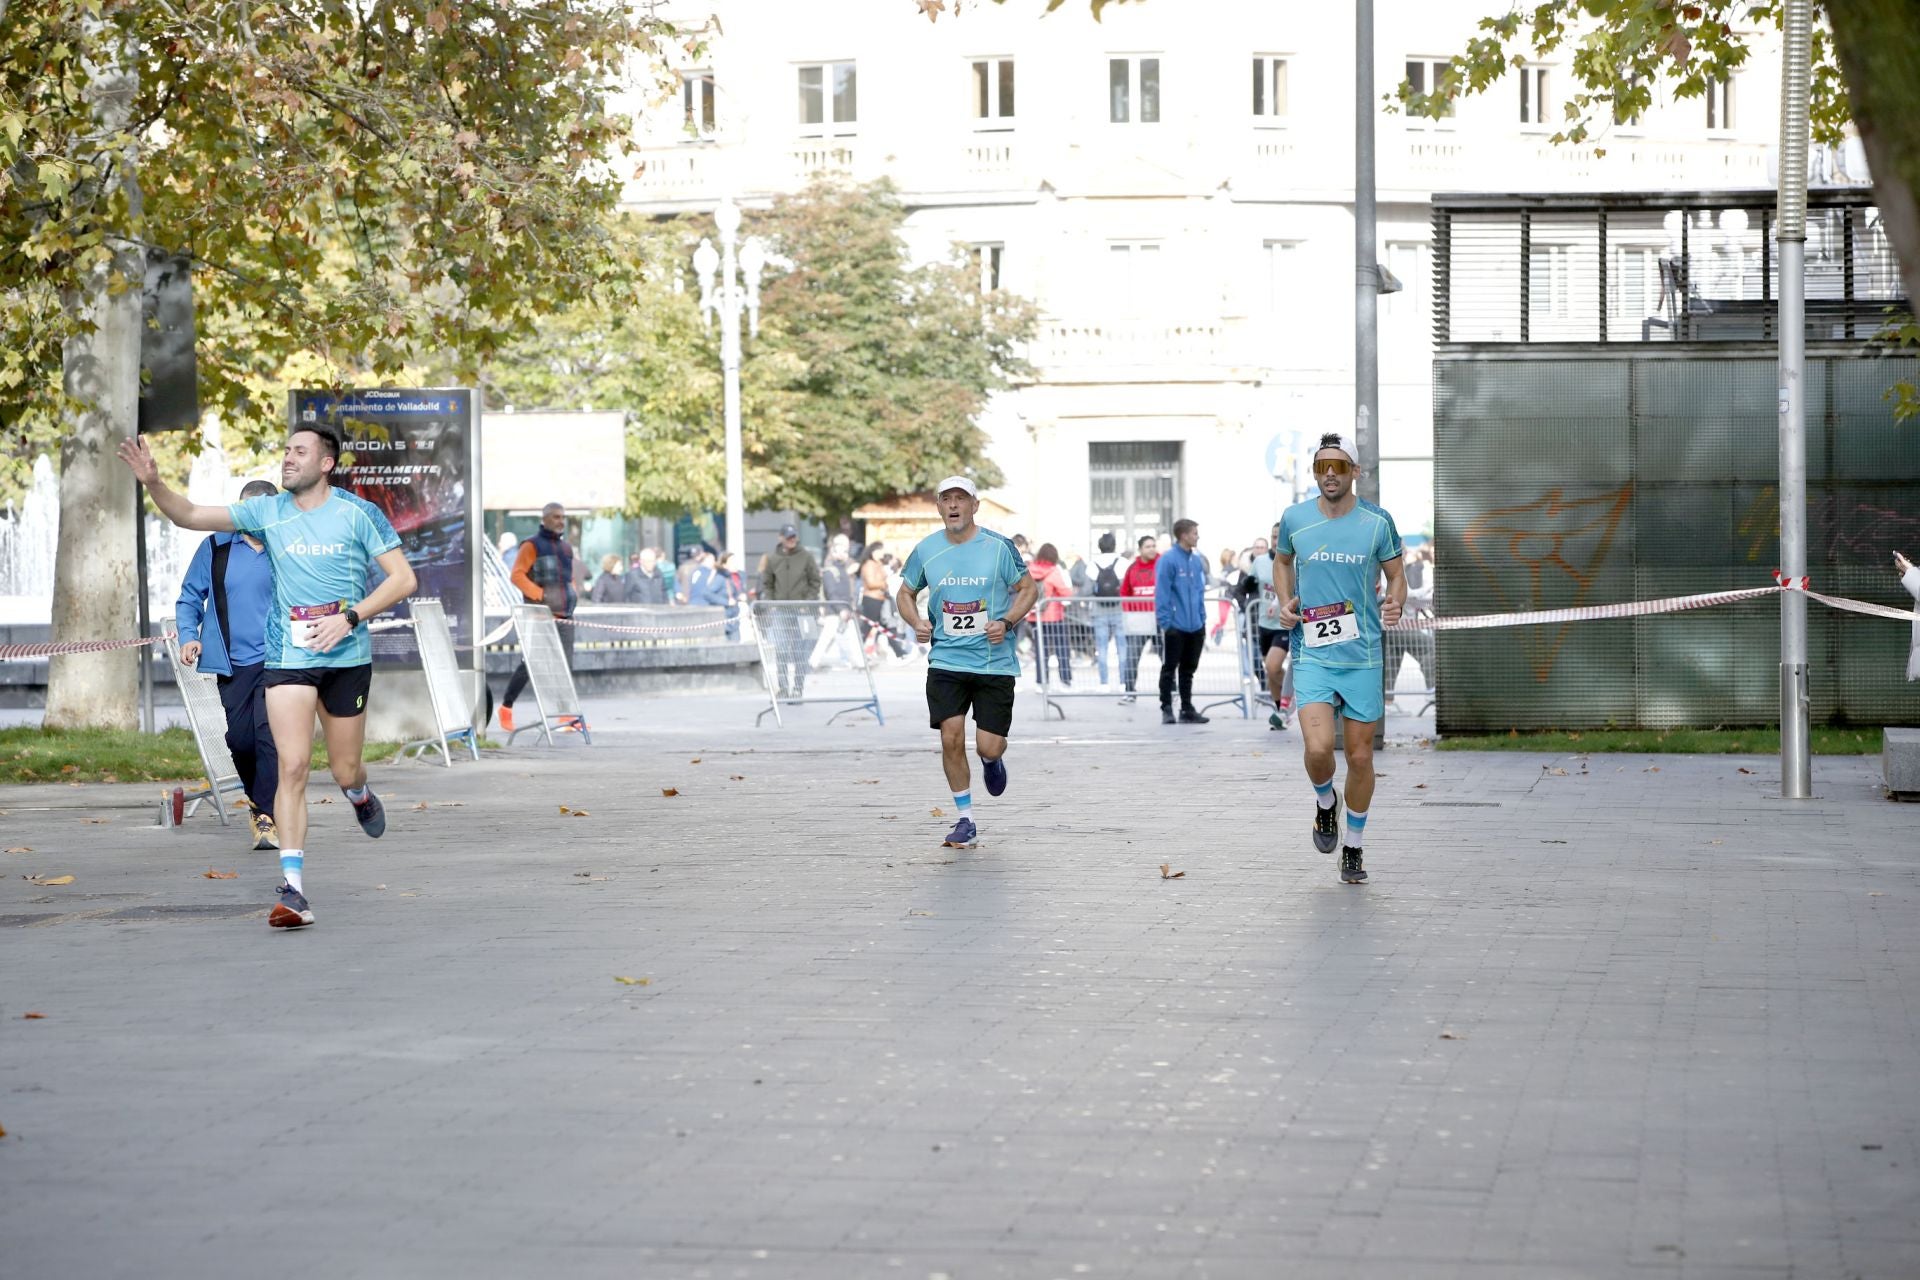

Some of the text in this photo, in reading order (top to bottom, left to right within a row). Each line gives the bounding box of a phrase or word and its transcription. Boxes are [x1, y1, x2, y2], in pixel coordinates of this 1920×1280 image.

[324, 400, 440, 412] Auntamiento de Valladolid
[285, 543, 345, 556] ADIENT
[1308, 552, 1365, 564] ADIENT
[938, 577, 987, 586] ADIENT
[953, 616, 975, 629] 22
[1315, 620, 1341, 638] 23
